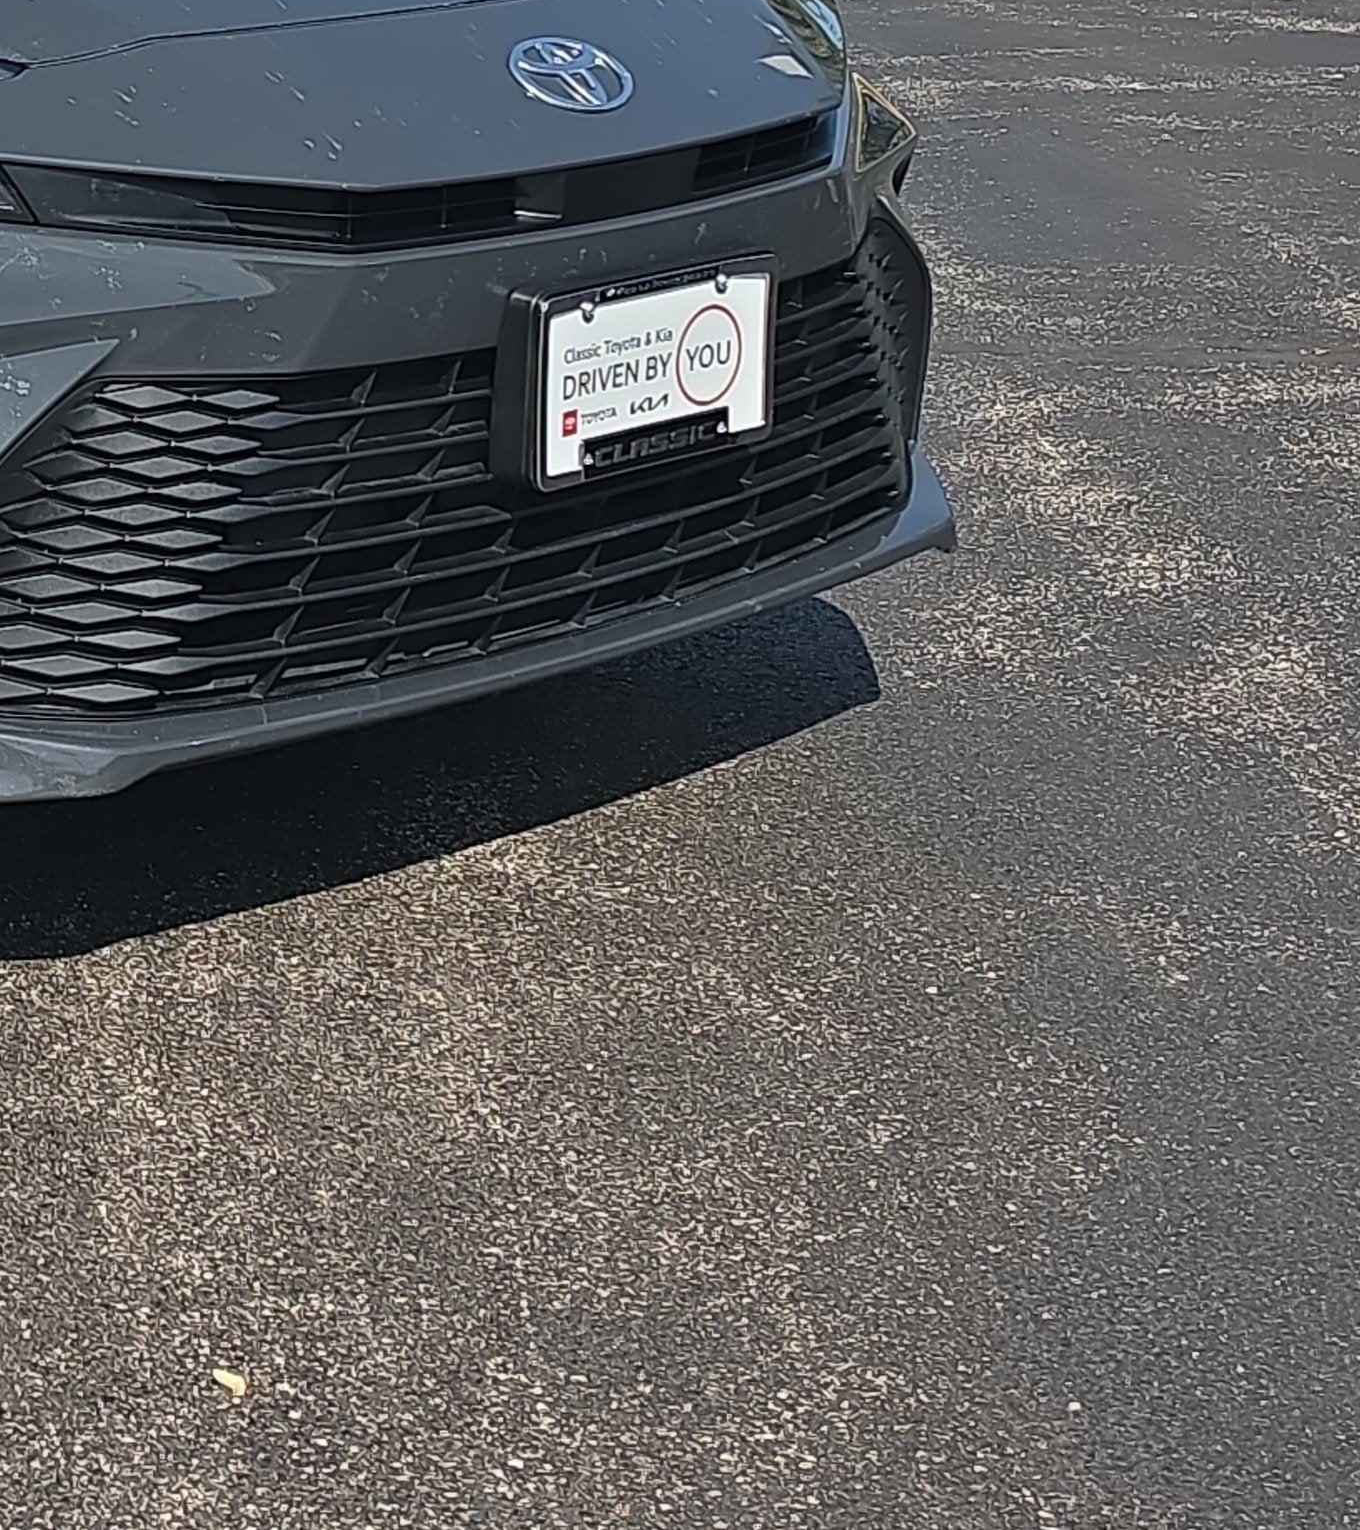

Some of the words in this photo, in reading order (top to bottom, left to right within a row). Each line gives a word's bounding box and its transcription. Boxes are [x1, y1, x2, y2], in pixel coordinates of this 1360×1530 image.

[564, 344, 601, 364] Classic
[604, 337, 641, 356] Toyota
[644, 331, 652, 346] &
[655, 328, 673, 343] Kia
[563, 359, 640, 401] DRIVEN
[645, 352, 672, 381] BY
[686, 340, 731, 371] YOU
[580, 407, 618, 425] TOYOTA
[594, 420, 717, 468] CLASSIC
